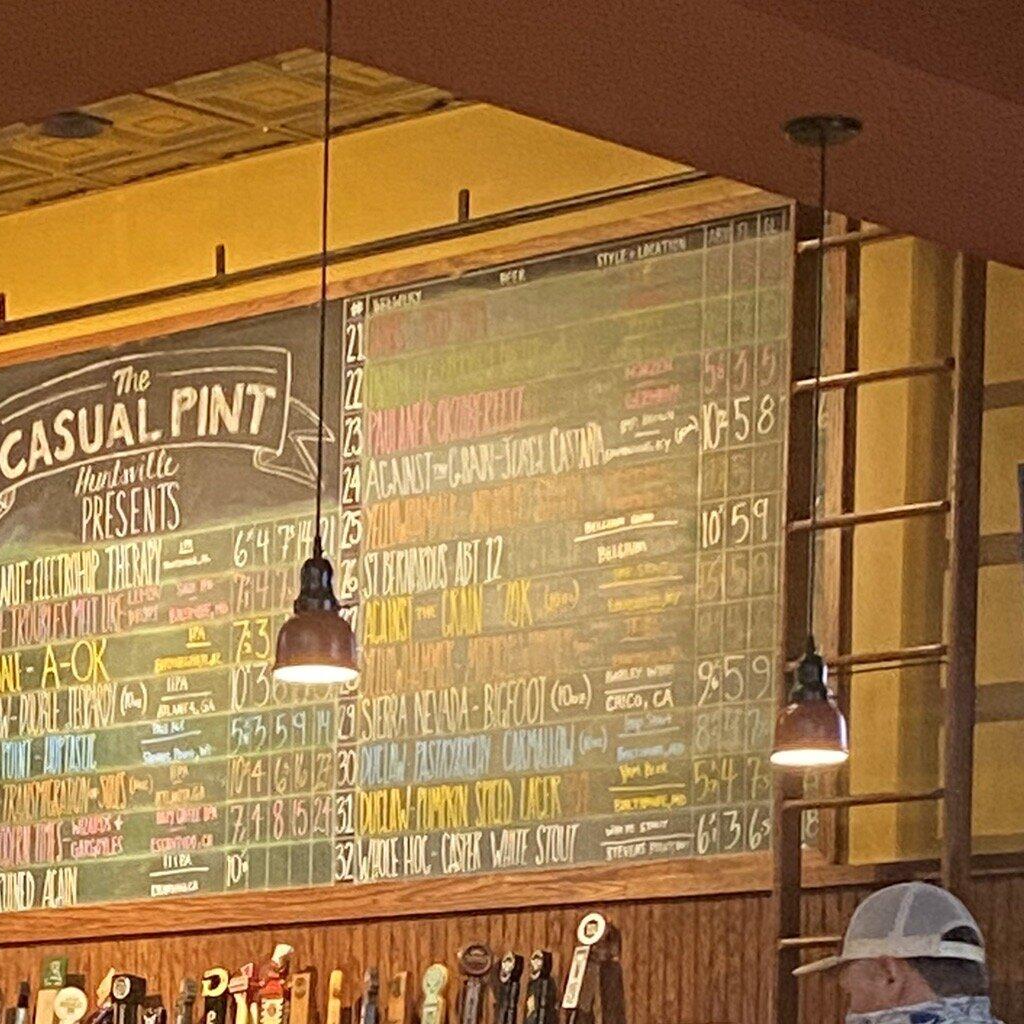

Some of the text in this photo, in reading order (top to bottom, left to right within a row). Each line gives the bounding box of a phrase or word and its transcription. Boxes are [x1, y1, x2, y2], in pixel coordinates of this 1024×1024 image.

[112, 365, 152, 397] The
[170, 382, 277, 438] PINT
[74, 448, 181, 498] Huntsville
[364, 451, 434, 503] AGAINST
[80, 480, 182, 544] PRESENTS
[455, 537, 482, 588] ABT
[40, 637, 111, 690] A-OK
[360, 692, 408, 743] SIERRA
[413, 685, 470, 735] NEVADA
[482, 675, 547, 731] BIGFOOT
[534, 822, 582, 866] STOUT
